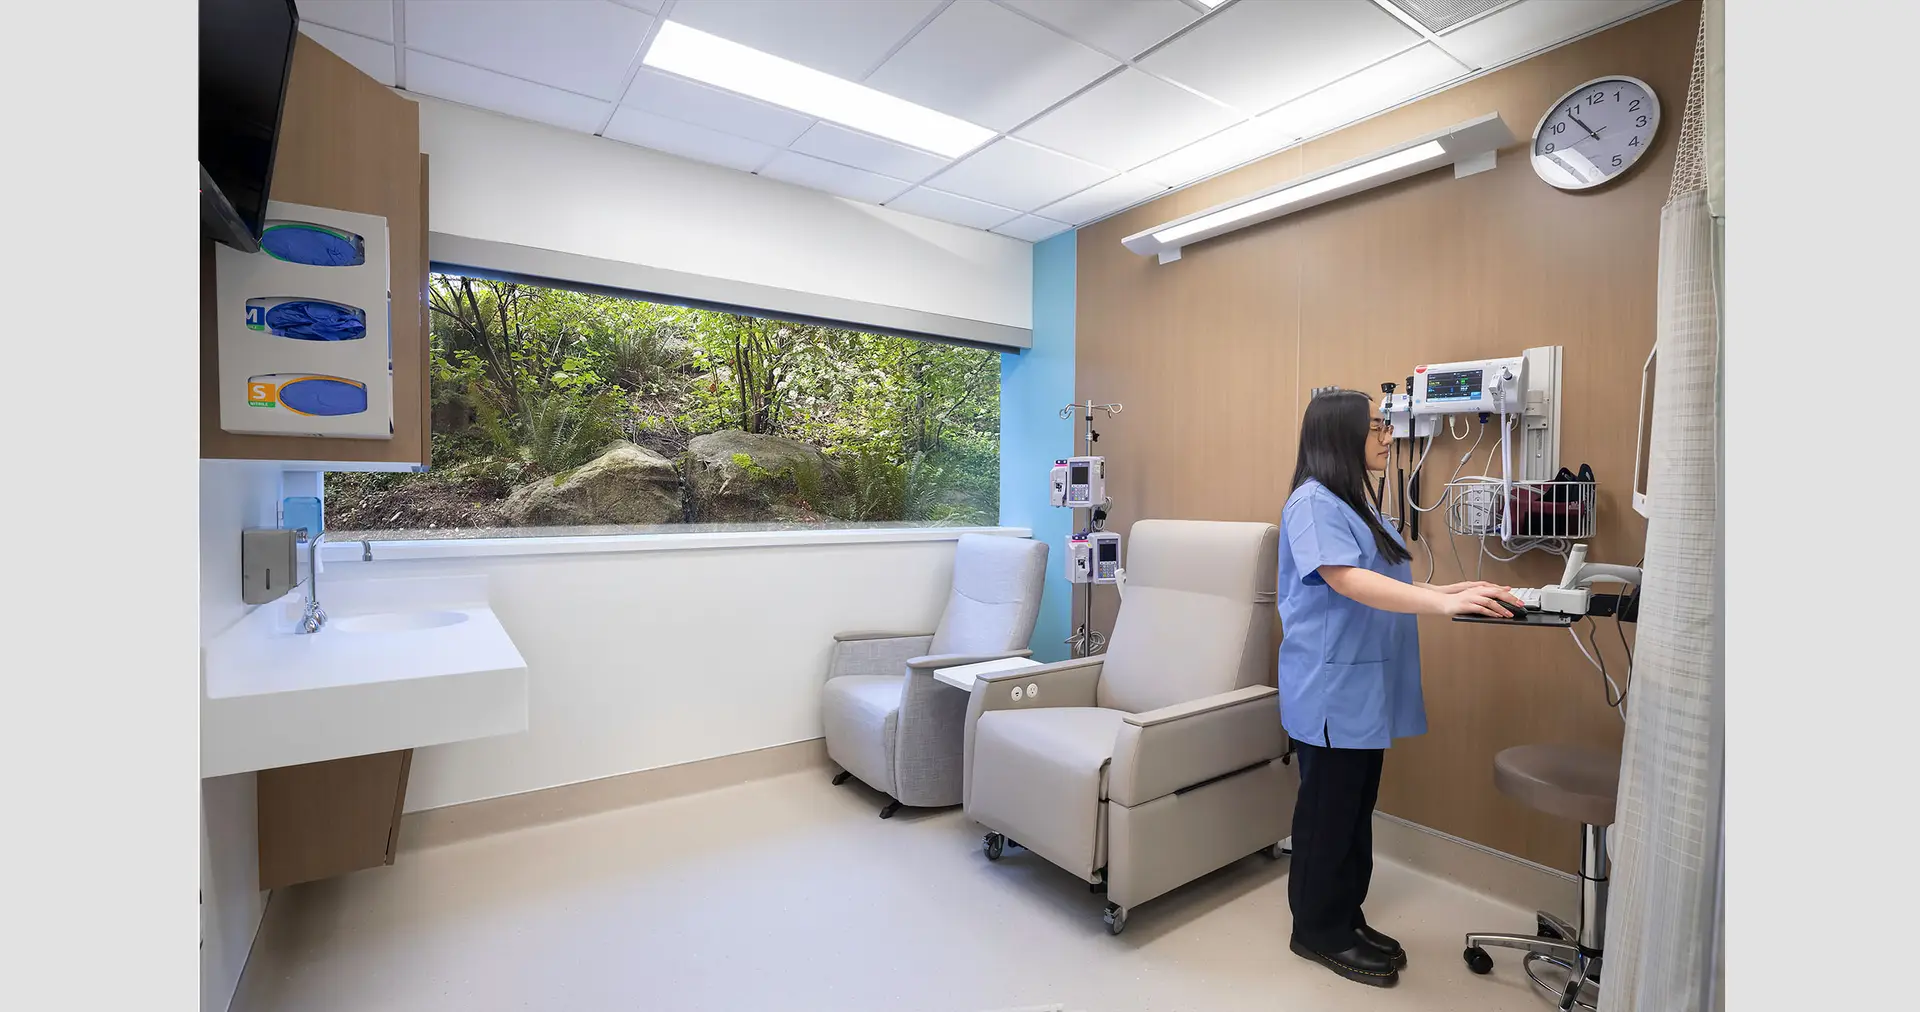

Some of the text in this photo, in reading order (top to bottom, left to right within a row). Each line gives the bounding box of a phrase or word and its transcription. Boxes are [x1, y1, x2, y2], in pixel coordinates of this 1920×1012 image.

[1586, 92, 1604, 105] 12
[1613, 91, 1620, 102] 1
[1566, 105, 1580, 116] 11
[1628, 100, 1640, 112] 2
[1635, 116, 1647, 128] 3
[1550, 122, 1566, 135] 10
[1628, 136, 1639, 147] 4
[1545, 143, 1555, 154] 9
[1611, 155, 1622, 167] 5
[246, 309, 257, 323] M
[253, 385, 266, 399] S
